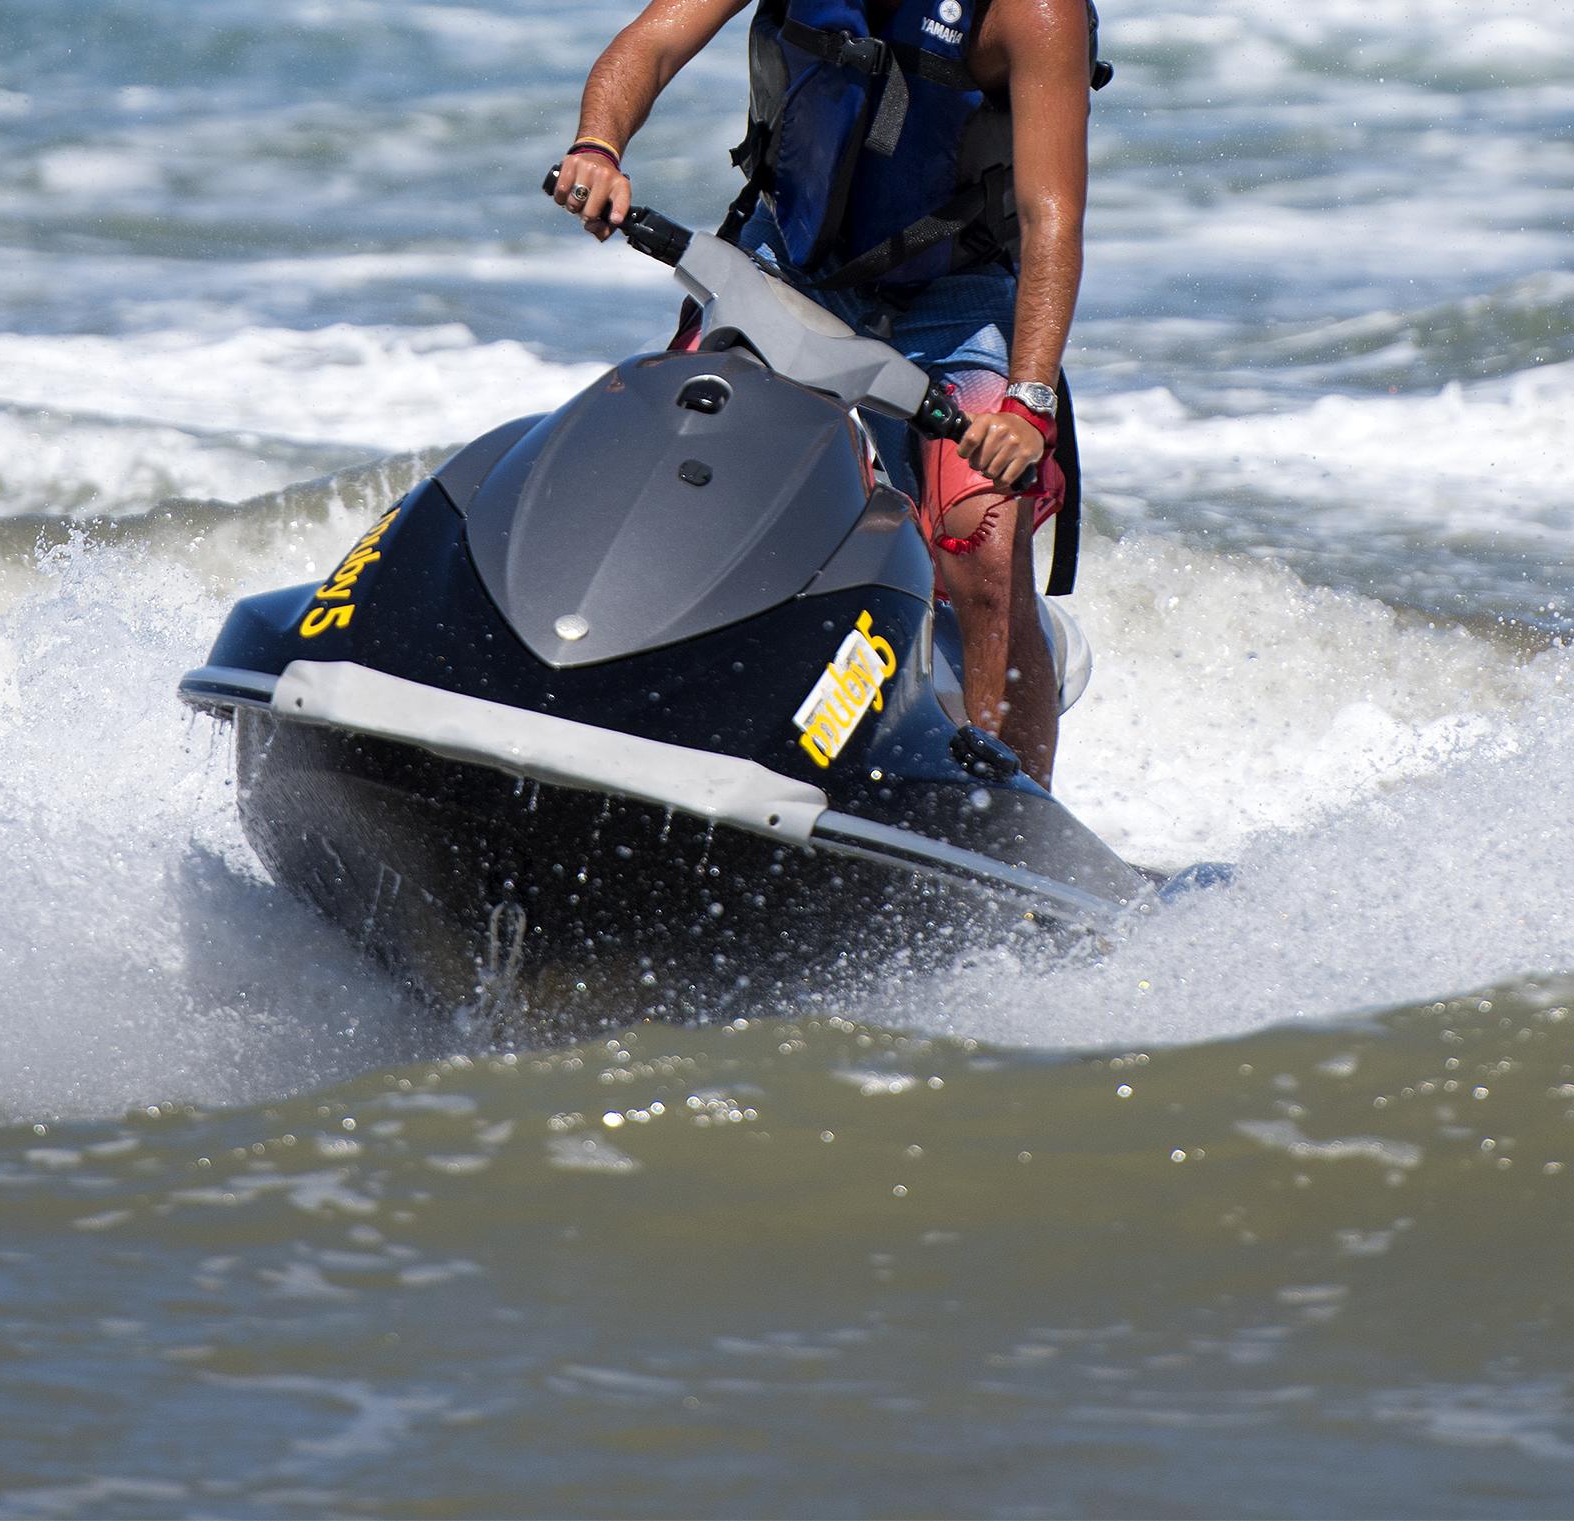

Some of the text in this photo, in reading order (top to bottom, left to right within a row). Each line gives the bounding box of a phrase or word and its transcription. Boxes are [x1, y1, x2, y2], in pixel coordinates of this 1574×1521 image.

[920, 16, 964, 44] YAMAHA
[299, 604, 356, 638] 5
[798, 609, 897, 768] muby 5
